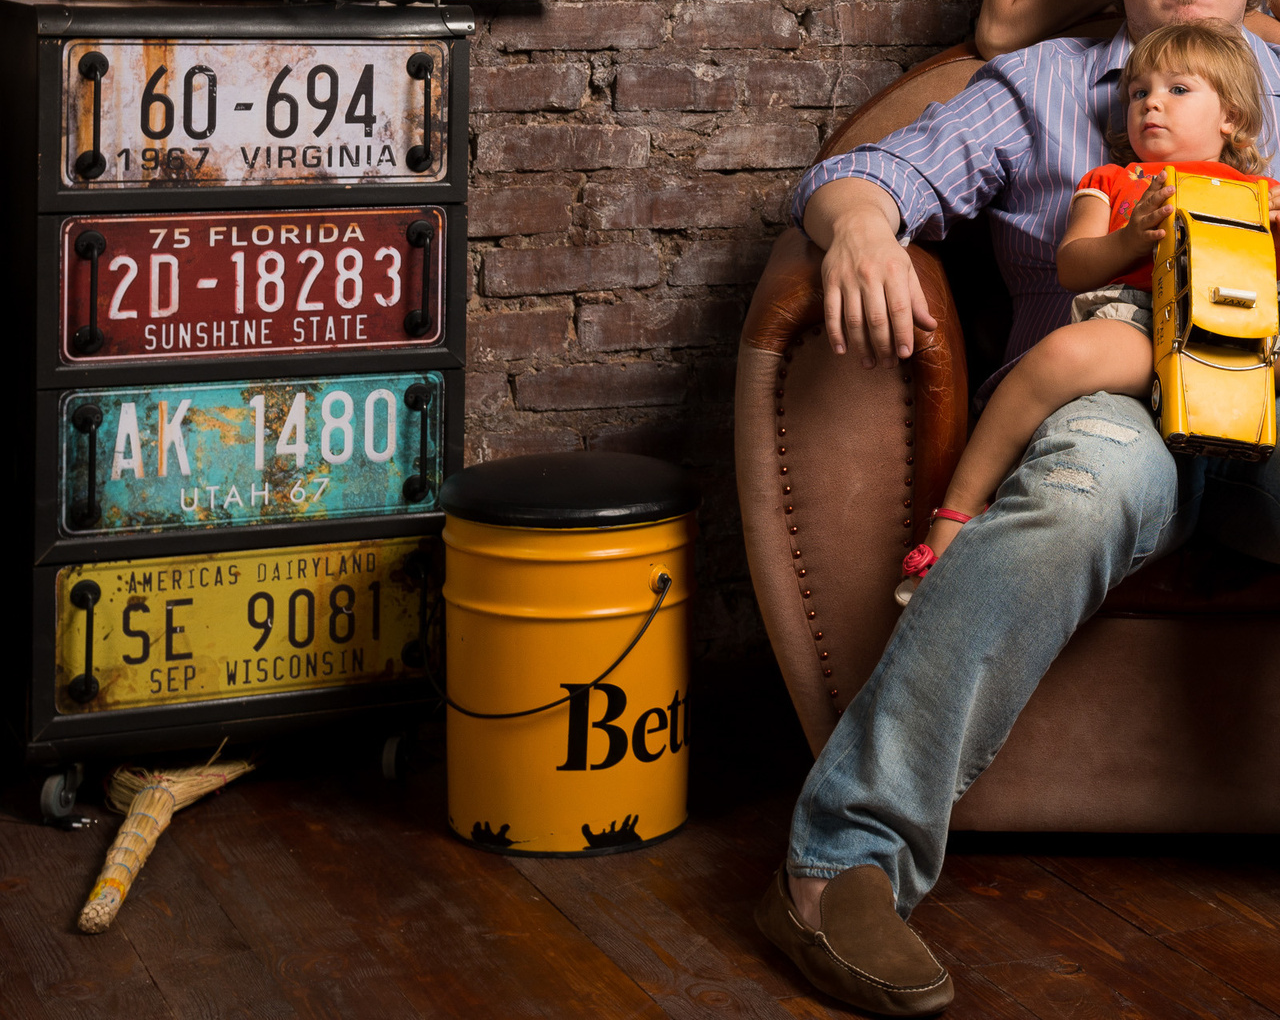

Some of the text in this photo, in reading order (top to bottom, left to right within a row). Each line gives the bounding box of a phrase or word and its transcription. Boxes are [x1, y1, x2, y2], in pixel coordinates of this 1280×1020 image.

[139, 63, 378, 141] 60-694
[116, 144, 398, 173] 1967 VIRGINIA
[148, 222, 366, 250] 75 FLORIDA
[1222, 297, 1247, 307] TAXI
[144, 314, 368, 351] SUNSHINE STATE
[109, 387, 398, 481] AK 1480
[179, 477, 330, 512] UTAH 67
[127, 551, 377, 594] AMERICAS DAIRYLAND
[121, 580, 381, 666] SE 9081
[226, 647, 364, 687] WISCONSIN
